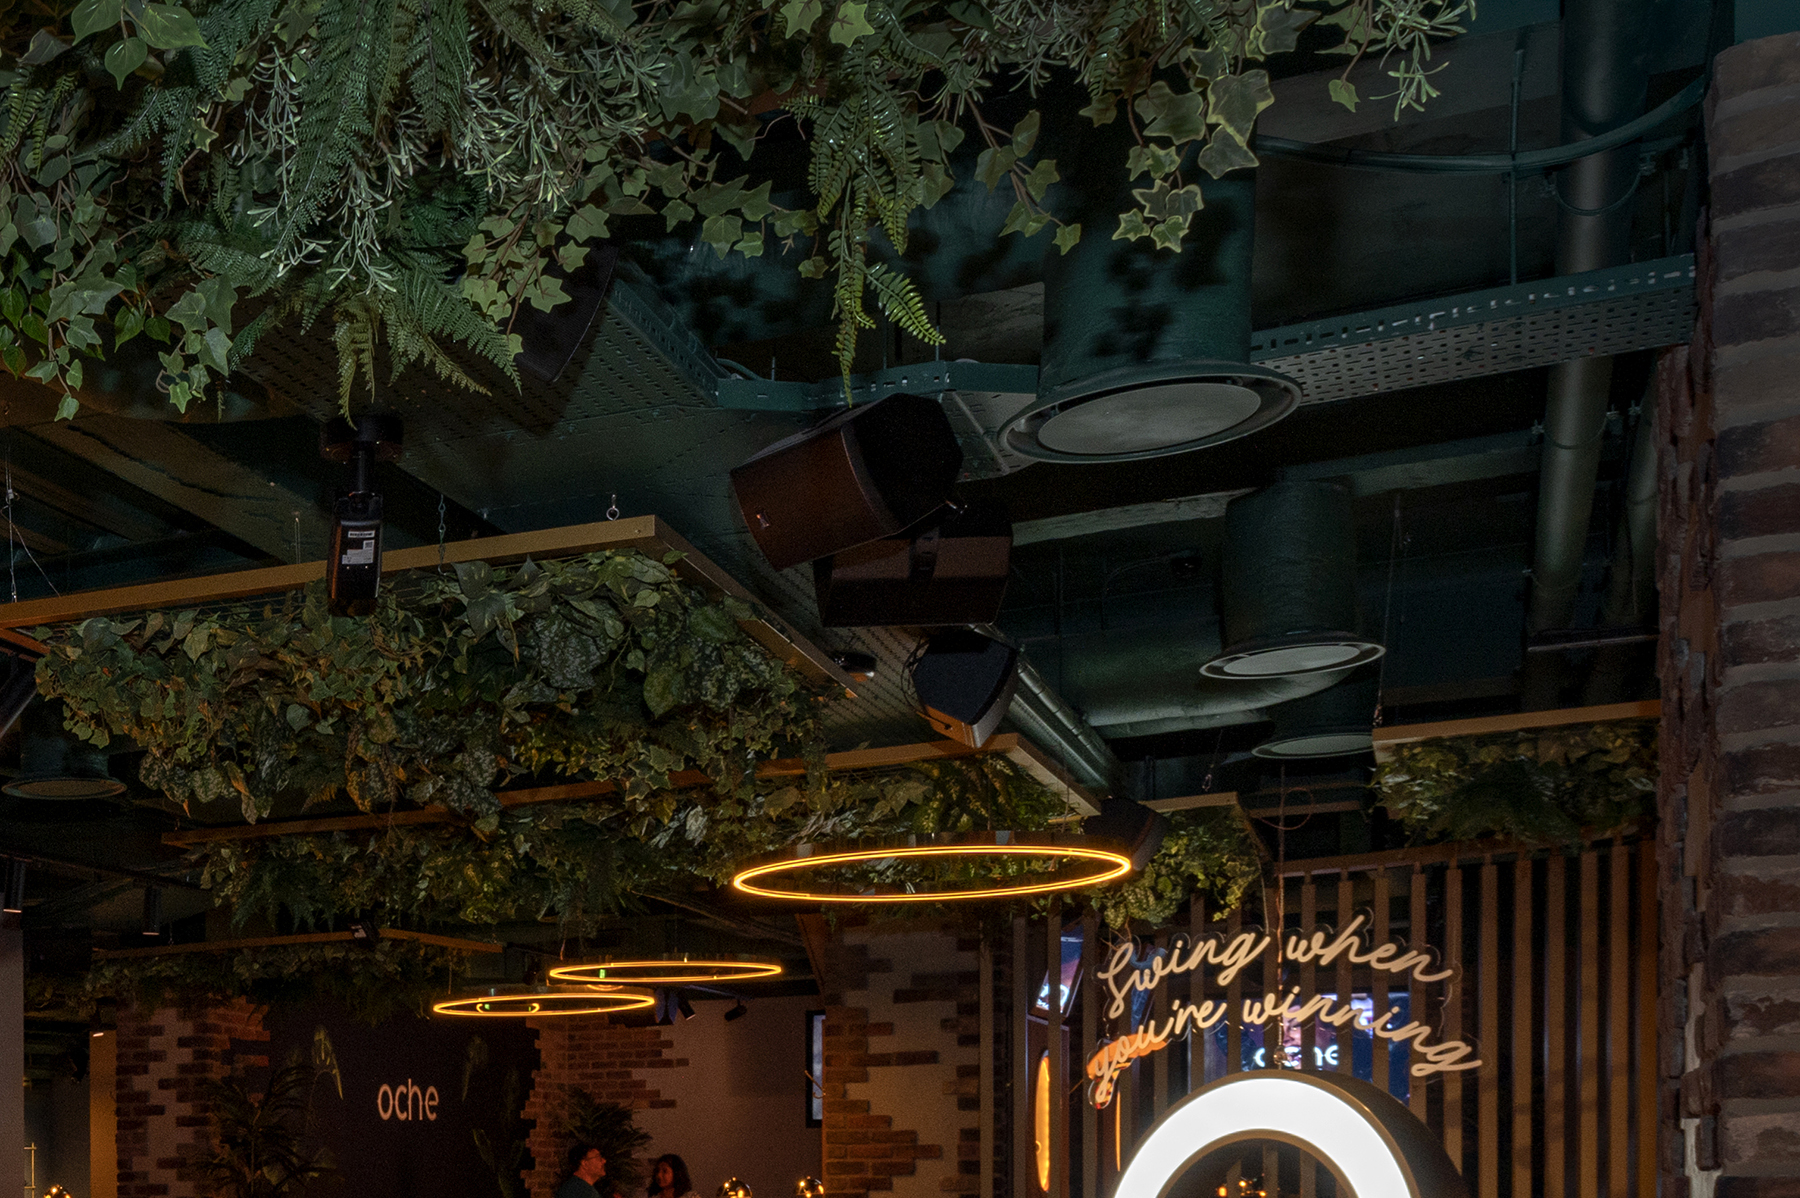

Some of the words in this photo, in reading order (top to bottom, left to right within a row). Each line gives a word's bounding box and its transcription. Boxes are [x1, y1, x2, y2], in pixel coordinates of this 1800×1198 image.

[1097, 932, 1271, 1019] Swing
[1286, 915, 1453, 982] when
[1095, 1000, 1228, 1104] you're
[1242, 986, 1483, 1077] winning
[377, 1078, 439, 1121] oche
